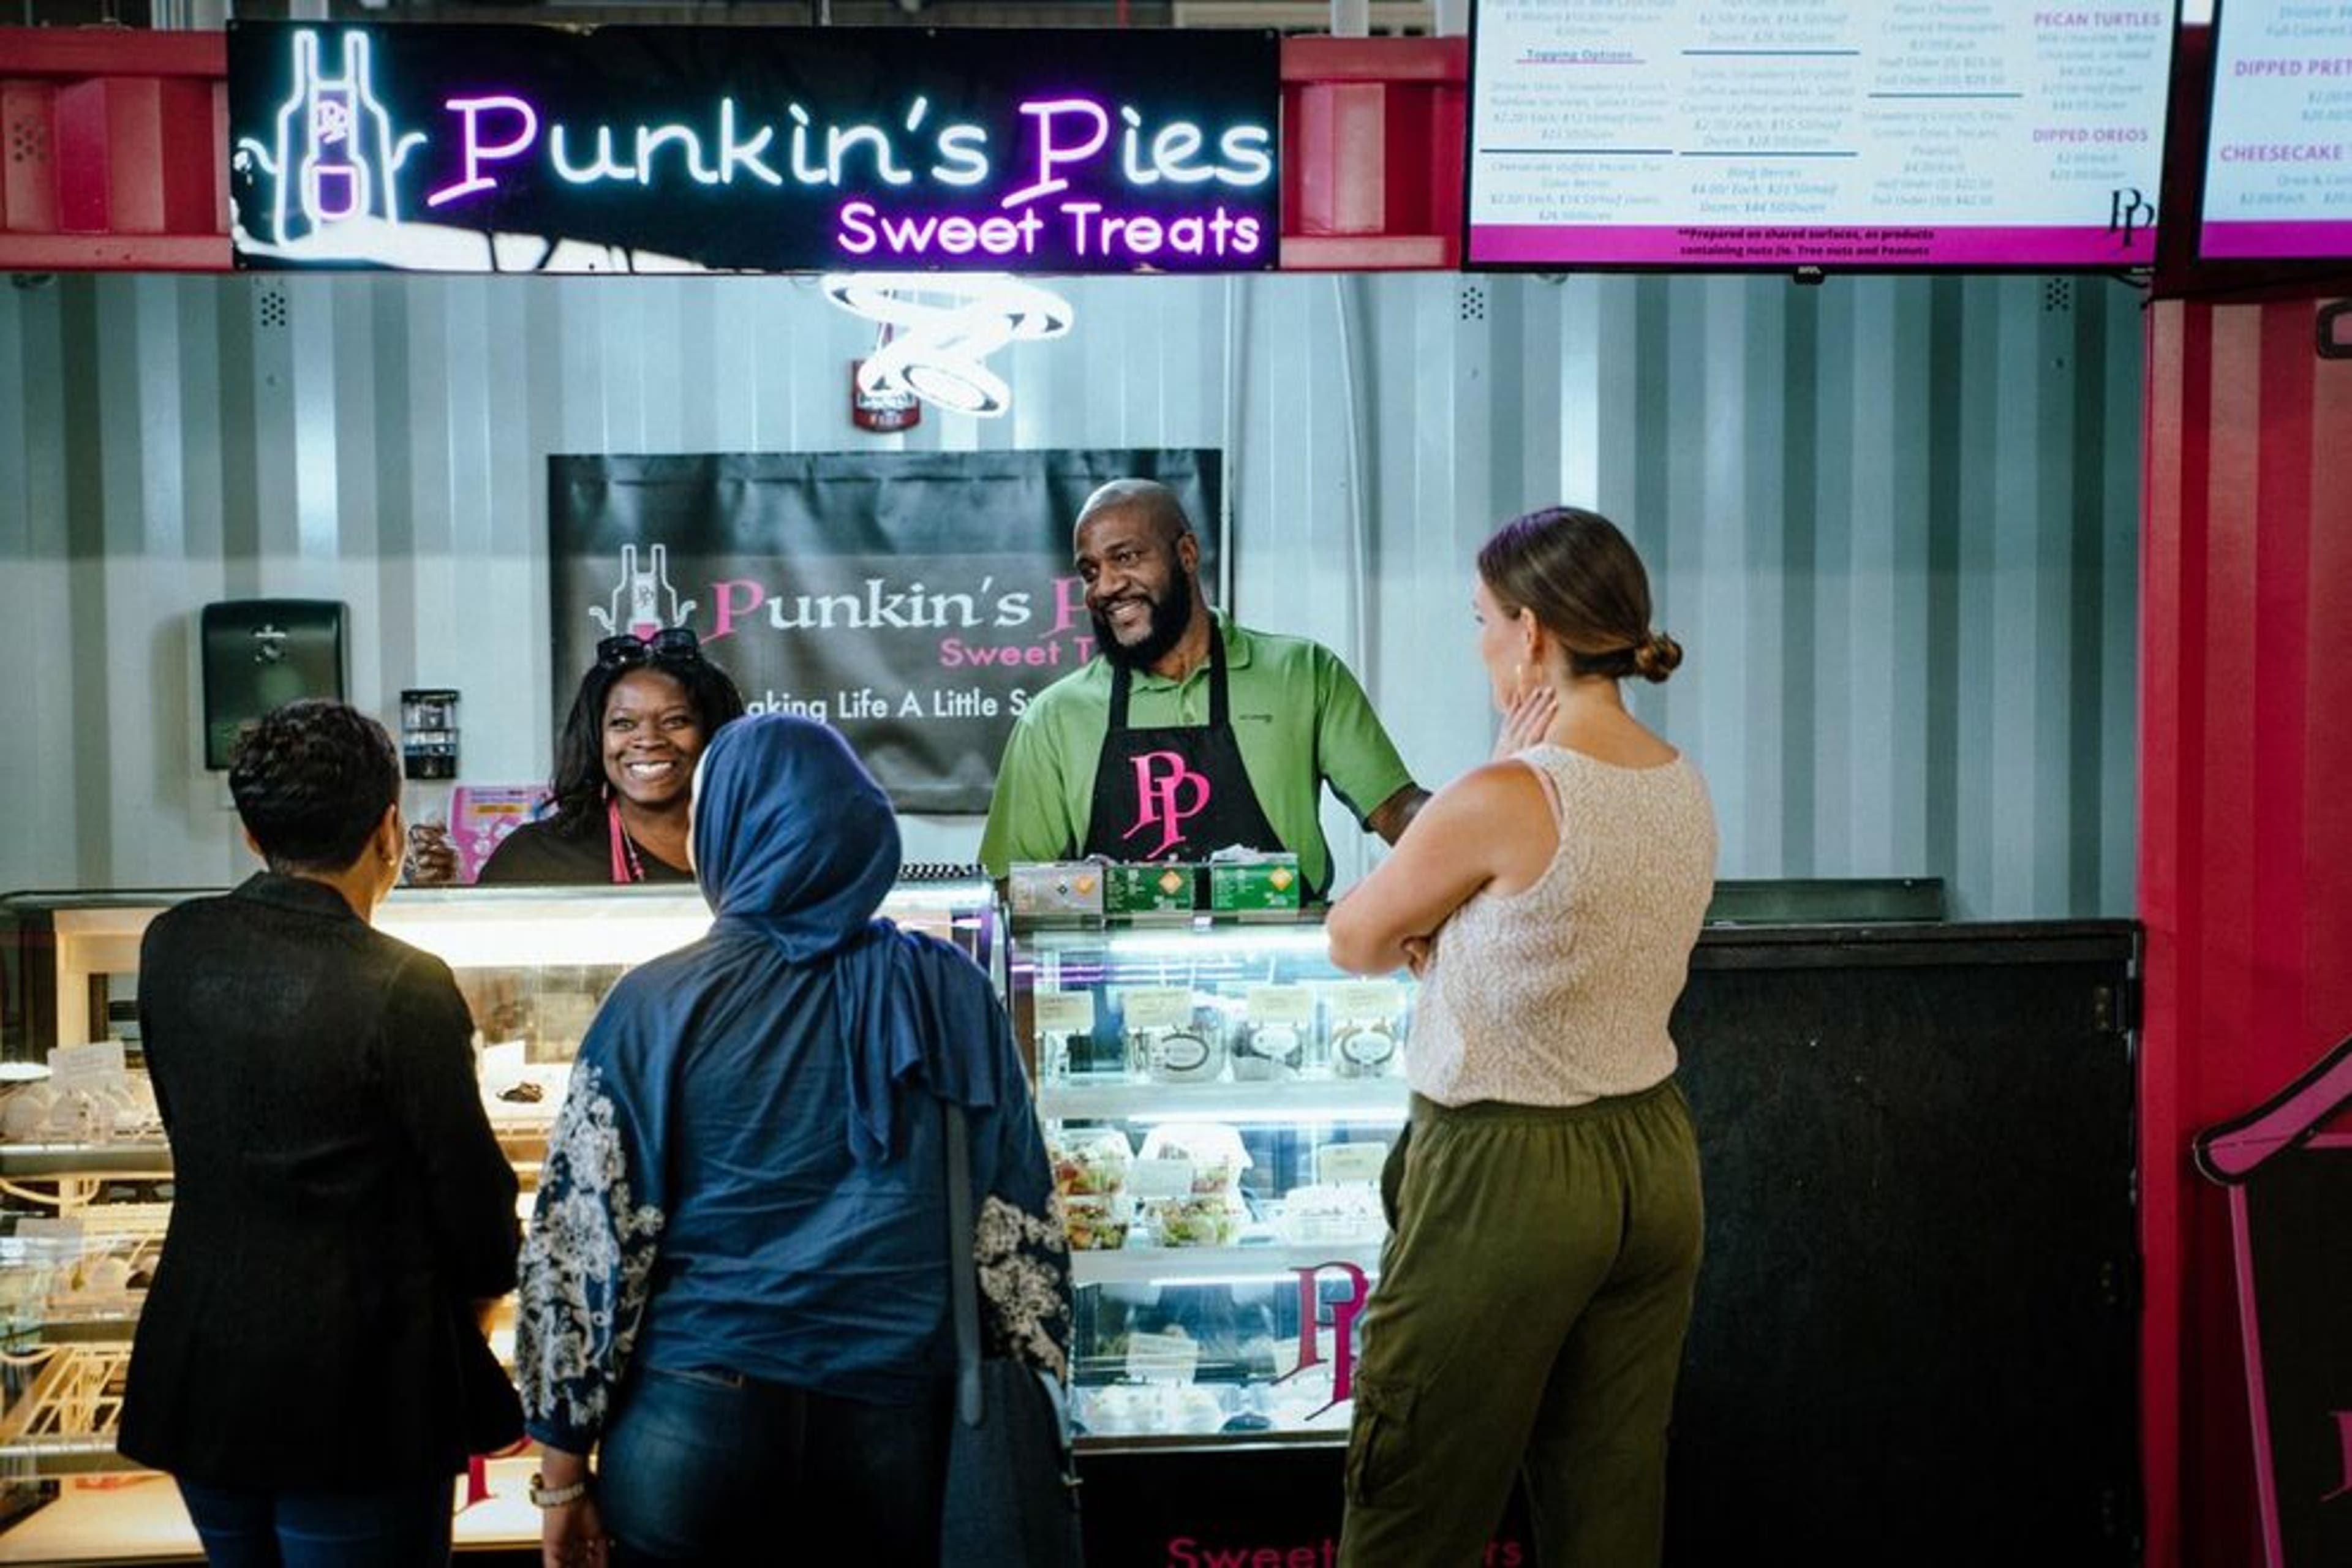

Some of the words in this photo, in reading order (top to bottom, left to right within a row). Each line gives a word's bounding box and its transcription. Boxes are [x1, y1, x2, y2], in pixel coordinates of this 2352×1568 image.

[2034, 12, 2088, 26] PECAN
[2094, 12, 2162, 26] TURTLES
[1526, 49, 1578, 61] Topping
[1581, 49, 1634, 61] Options
[2235, 60, 2302, 76] DIPPED
[2033, 129, 2089, 142] DIPPED
[2092, 129, 2149, 142] OREOS
[428, 96, 990, 206] Punkin's
[1001, 98, 1273, 209] Pies
[2220, 145, 2343, 162] CHEESECAKE
[838, 202, 1044, 255] Sweet
[1060, 203, 1261, 256] Treats
[1765, 228, 1805, 239] shared
[1808, 228, 1862, 241] surfaces,
[1881, 229, 1934, 241] products
[1679, 246, 1744, 257] containing
[1798, 246, 1823, 255] Tree
[1856, 247, 1877, 255] and
[1882, 246, 1929, 255] Peanuts
[699, 576, 1031, 646] Punkin's
[941, 638, 1061, 667] Sweet
[739, 690, 827, 725] aking
[838, 690, 888, 718] Life
[898, 692, 924, 717] A
[934, 688, 998, 717] Little
[1121, 750, 1211, 859] PP
